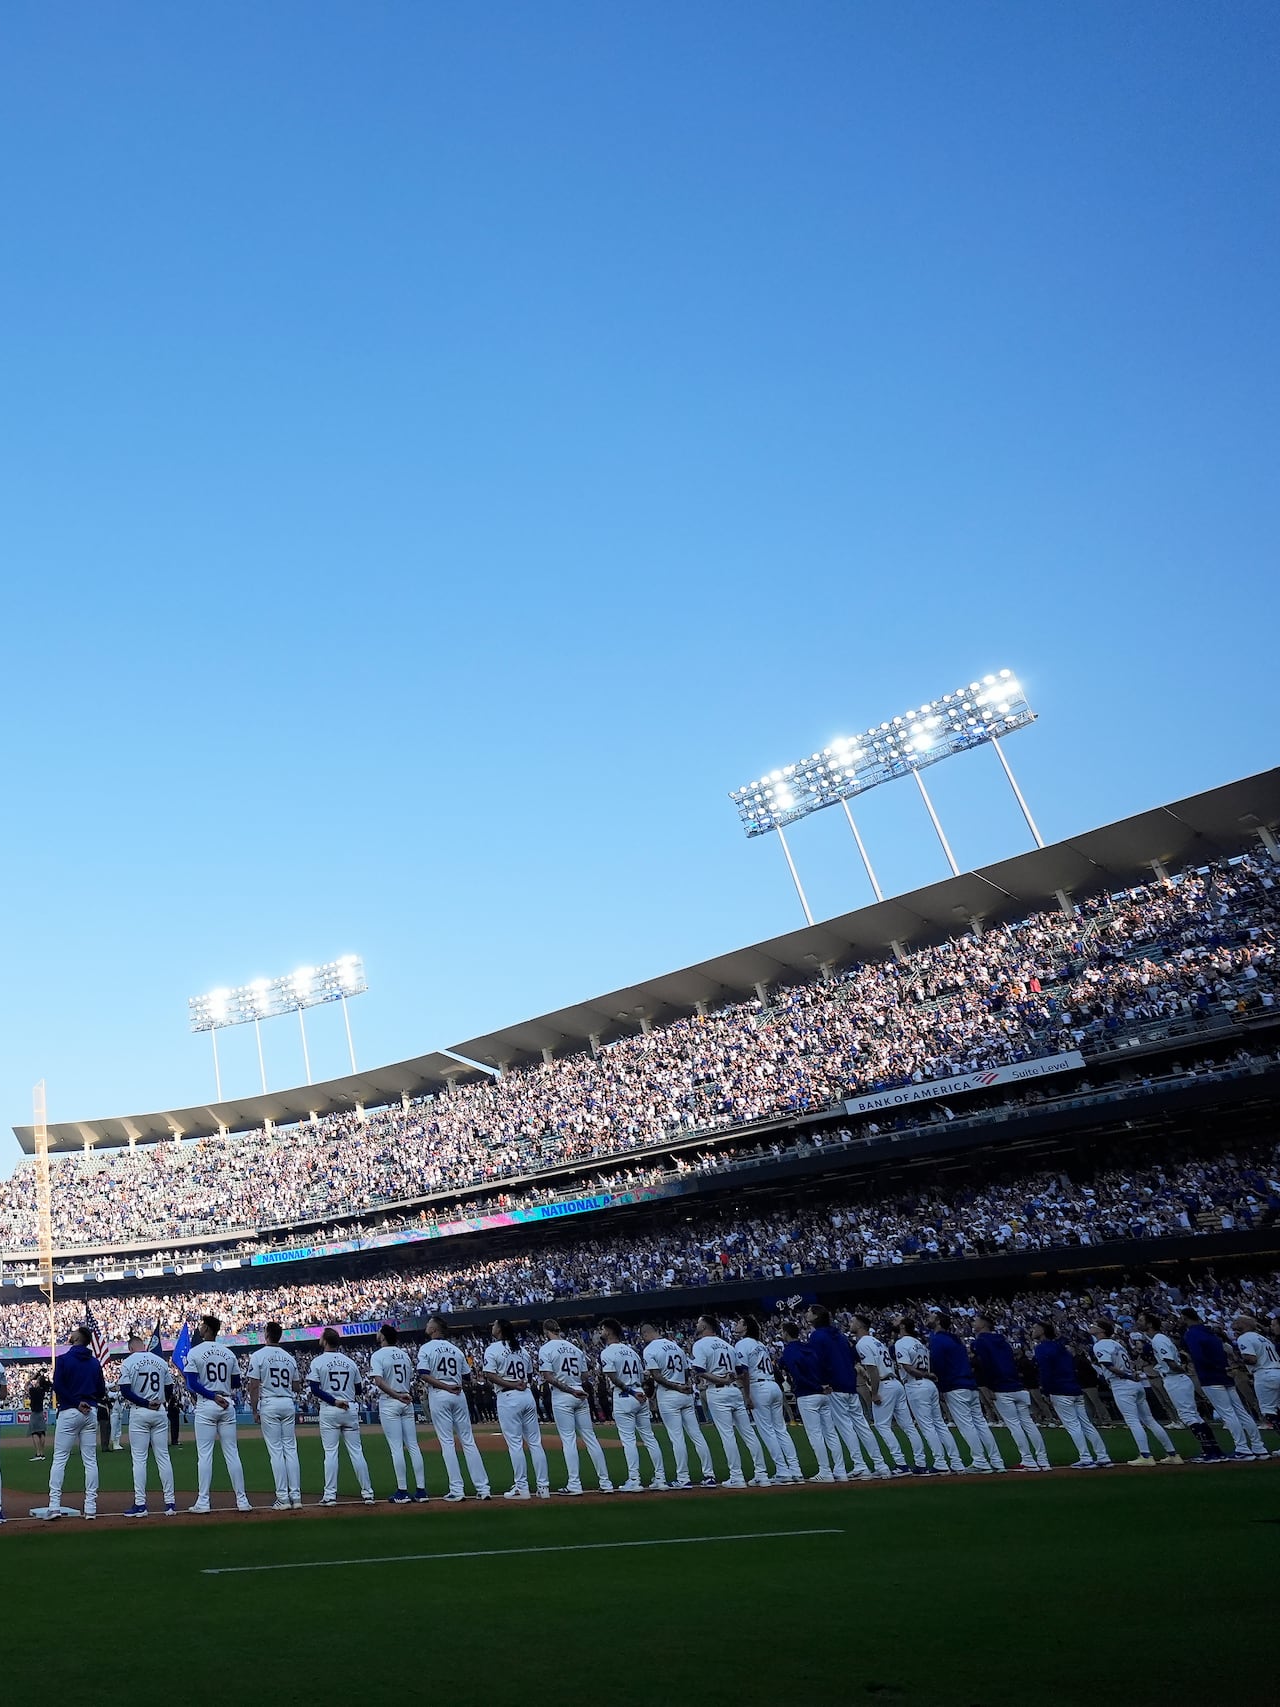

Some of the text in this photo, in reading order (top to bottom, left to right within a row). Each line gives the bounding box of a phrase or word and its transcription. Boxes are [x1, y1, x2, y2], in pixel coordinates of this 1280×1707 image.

[1012, 1059, 1070, 1079] Suite Level
[858, 1080, 971, 1111] BANK OF AMERICA
[541, 1199, 601, 1218] NATIONAL
[262, 1250, 305, 1264] NATIONAL
[342, 1322, 382, 1335] NATIONA
[437, 1357, 458, 1377] 49
[506, 1360, 526, 1379] 48
[561, 1357, 579, 1377] 45
[622, 1360, 640, 1379] 44
[667, 1354, 683, 1374] 43
[718, 1353, 733, 1371] 41
[758, 1354, 774, 1376] 40
[138, 1371, 161, 1393] 78
[206, 1362, 227, 1383] 60
[269, 1367, 290, 1388] 59
[328, 1371, 350, 1392] 57
[393, 1364, 407, 1384] 51
